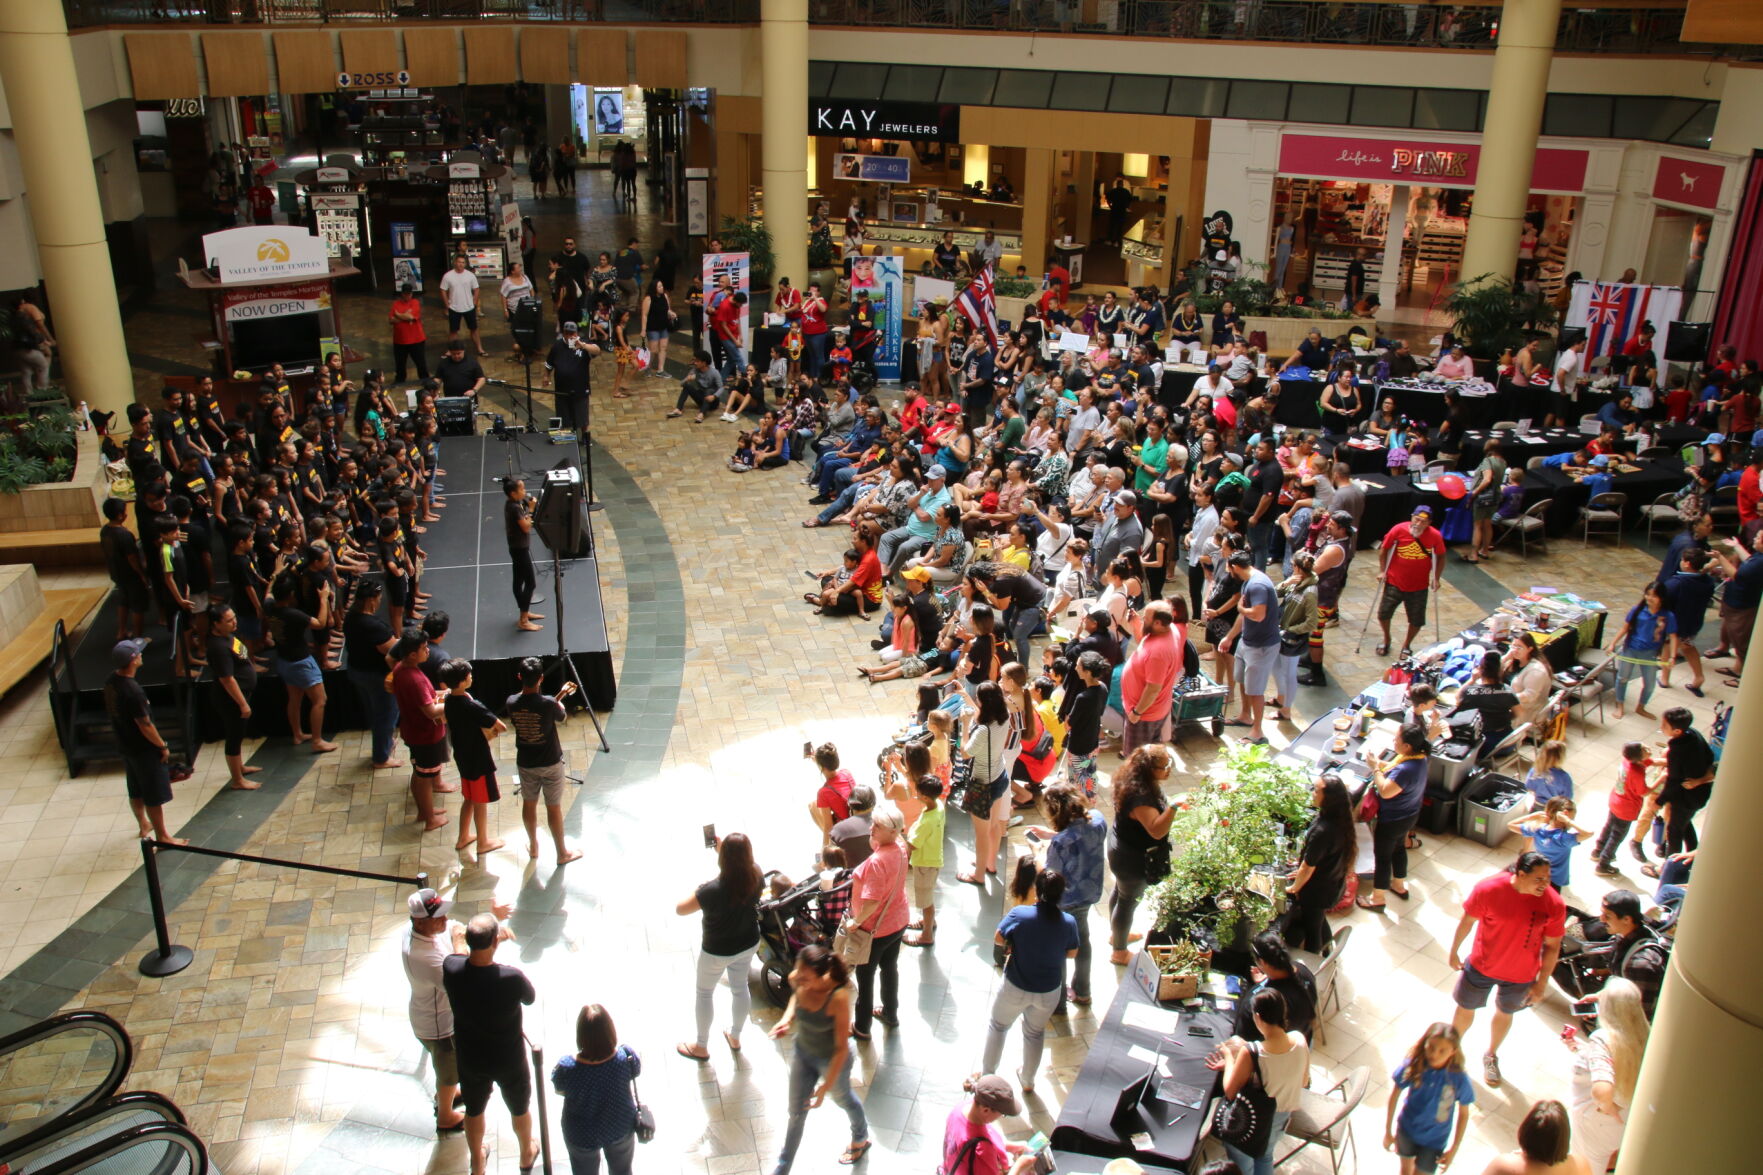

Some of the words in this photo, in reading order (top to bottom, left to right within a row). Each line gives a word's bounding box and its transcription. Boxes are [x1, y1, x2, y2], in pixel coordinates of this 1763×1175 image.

[353, 72, 395, 86] ROSS
[818, 107, 877, 132] KAY
[880, 123, 938, 135] JEWELERS
[1335, 150, 1367, 166] life
[1367, 153, 1383, 163] is
[1391, 148, 1469, 177] PINK
[228, 267, 257, 275] VALLEY
[287, 261, 321, 270] TEMPLES
[227, 293, 249, 302] Valley
[257, 290, 269, 298] the
[271, 287, 298, 298] Temples
[299, 284, 328, 295] Mortuary
[231, 304, 266, 318] NOW
[269, 301, 305, 315] OPEN
